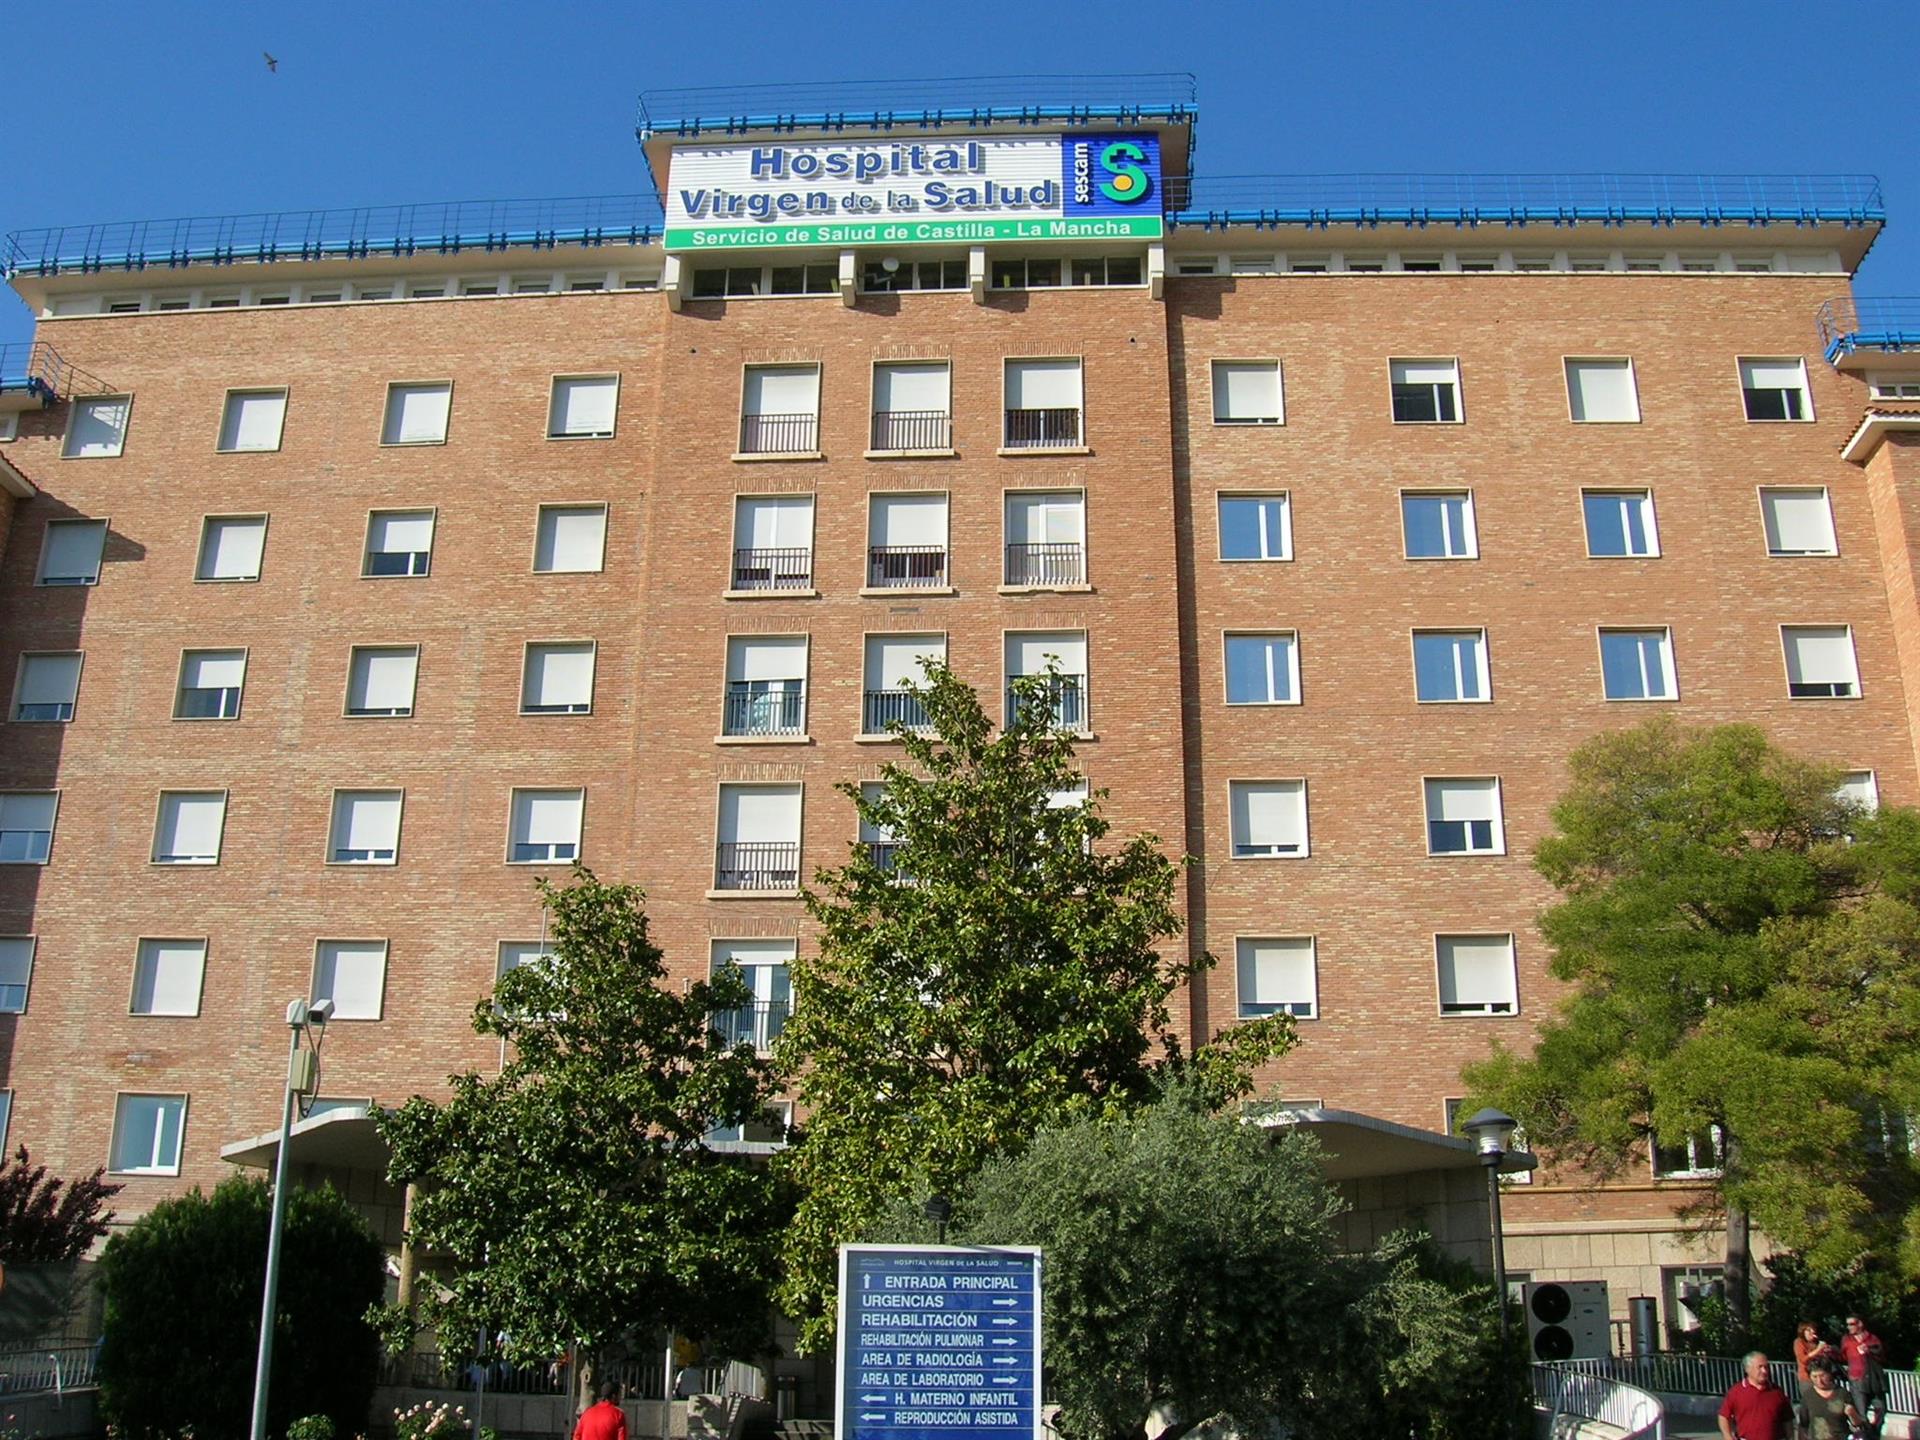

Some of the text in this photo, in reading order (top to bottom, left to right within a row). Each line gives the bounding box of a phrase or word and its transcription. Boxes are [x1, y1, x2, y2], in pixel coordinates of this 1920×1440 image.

[751, 141, 978, 178] Hospital
[1074, 143, 1088, 203] sescam
[680, 179, 1053, 216] Virgen de la Salud
[692, 229, 778, 246] Servicio
[785, 228, 810, 242] de
[817, 226, 876, 241] Salud
[884, 225, 908, 240] de
[916, 223, 994, 239] Castilla
[1017, 221, 1042, 236] La
[1049, 219, 1131, 236] Mancha
[884, 1276, 1019, 1289] ENTRADA PRINCIPAL
[862, 1295, 944, 1308] URGENCIAS
[861, 1312, 978, 1327] REHABILITACIÓN
[860, 1332, 984, 1347] REHABILITACIÓN PULMONAR
[861, 1351, 984, 1367] AREA DE RADIOLOGÍA
[860, 1373, 984, 1386] AREA DE LABORATORIO
[894, 1393, 1019, 1406] H. MATERNO INFANTIL
[894, 1410, 1019, 1425] REPRODUCCIÓN ASISTIDA
